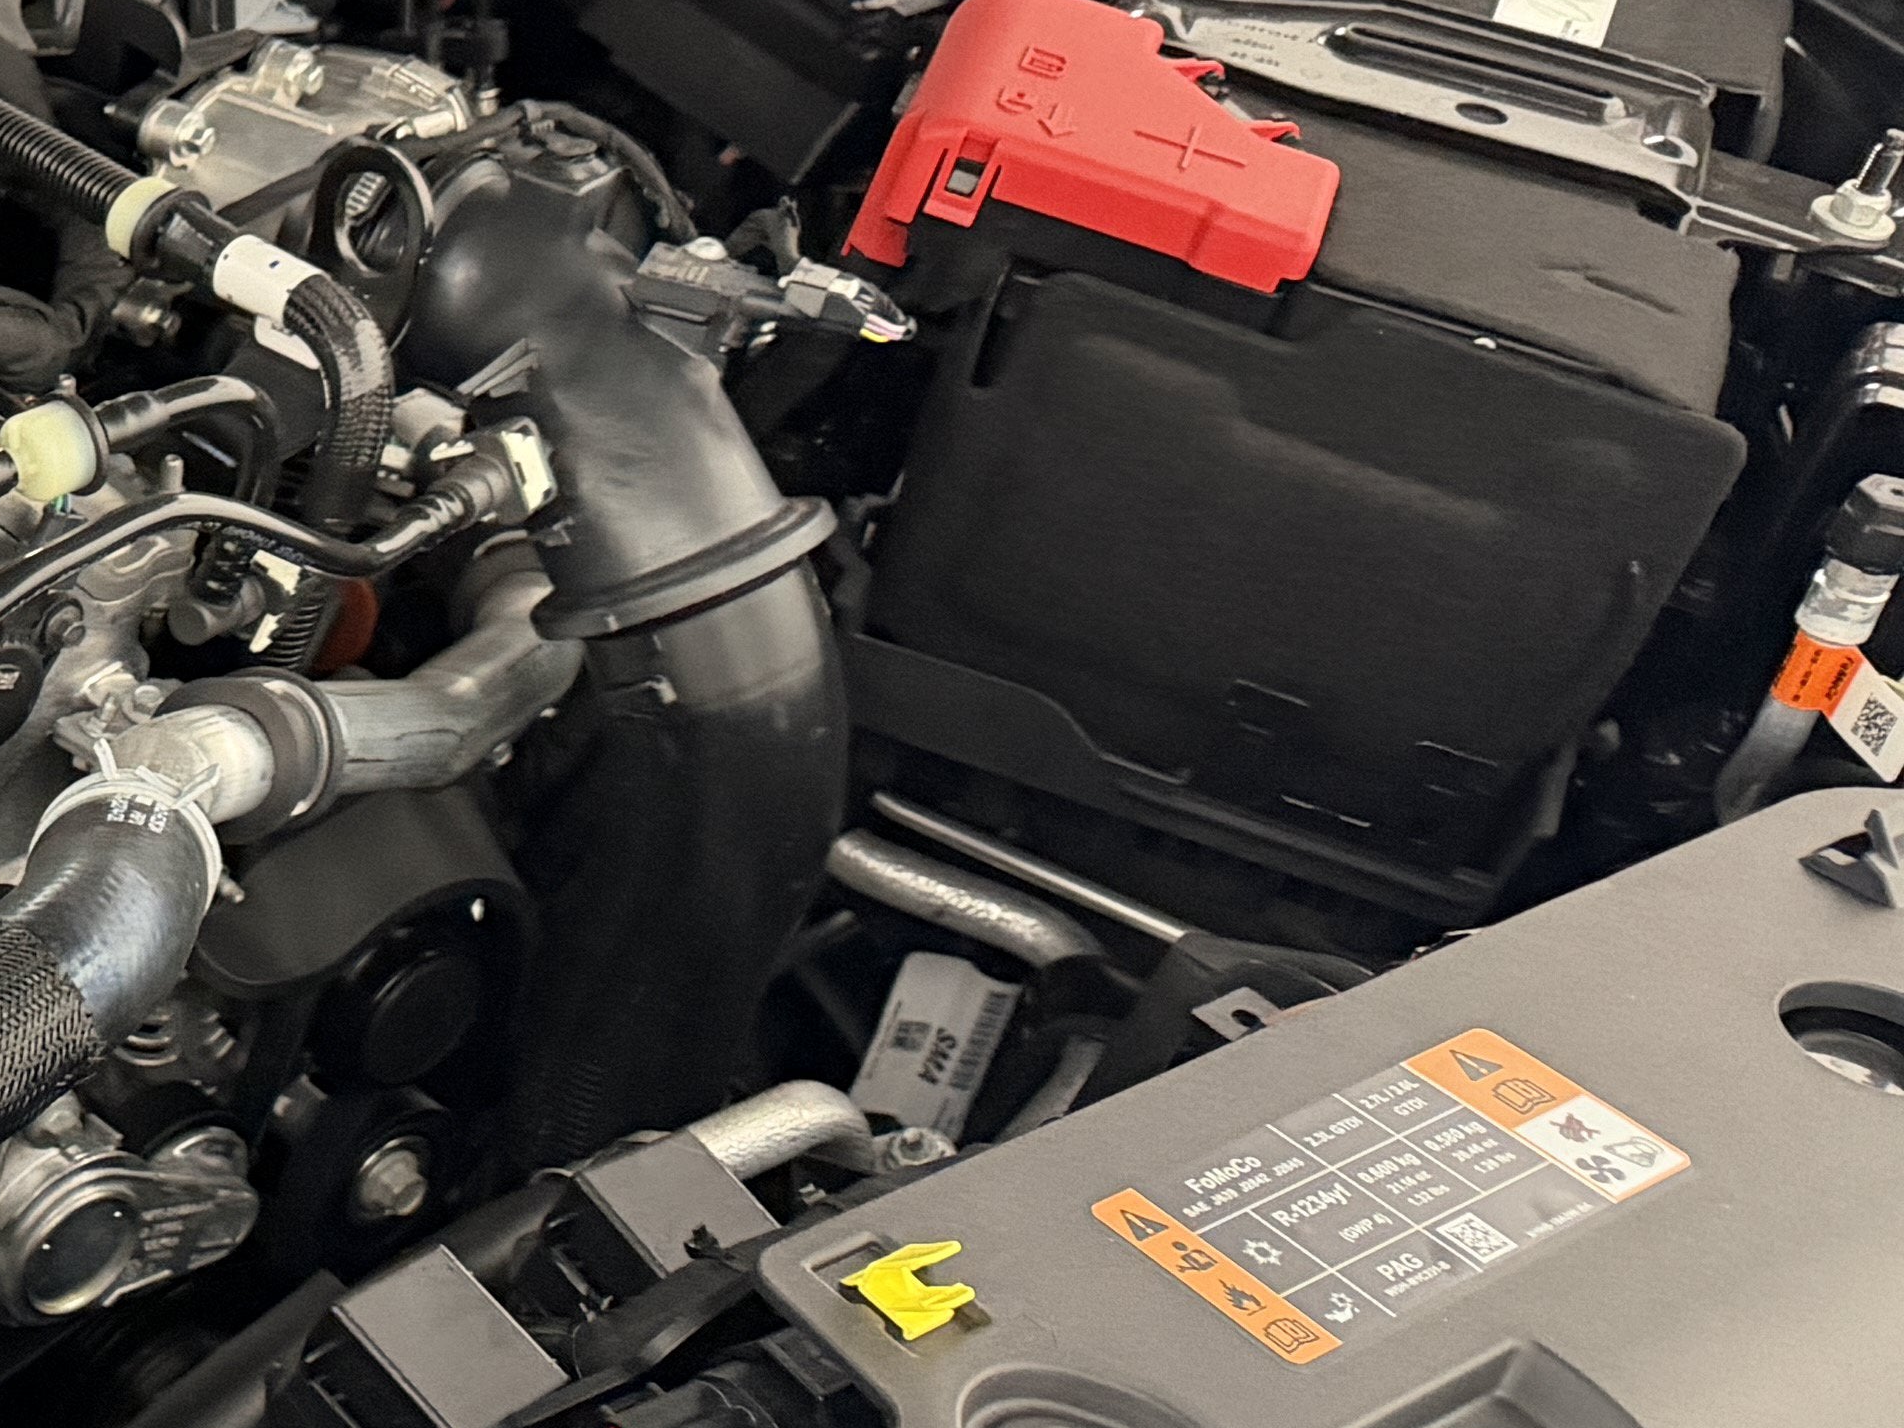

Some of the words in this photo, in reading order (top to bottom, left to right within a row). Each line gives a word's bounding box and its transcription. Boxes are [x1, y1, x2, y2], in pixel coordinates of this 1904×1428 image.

[1393, 1097, 1428, 1117] GTDI
[1330, 1115, 1364, 1136] GTDI
[1461, 1121, 1487, 1136] kg
[1394, 1152, 1422, 1168] kg
[1184, 1156, 1262, 1195] FoMoCo
[1182, 1201, 1212, 1218] SAE
[1271, 1182, 1353, 1227] R-1234yf
[1339, 1220, 1375, 1243] (GWP
[1376, 1252, 1424, 1282] PAG
